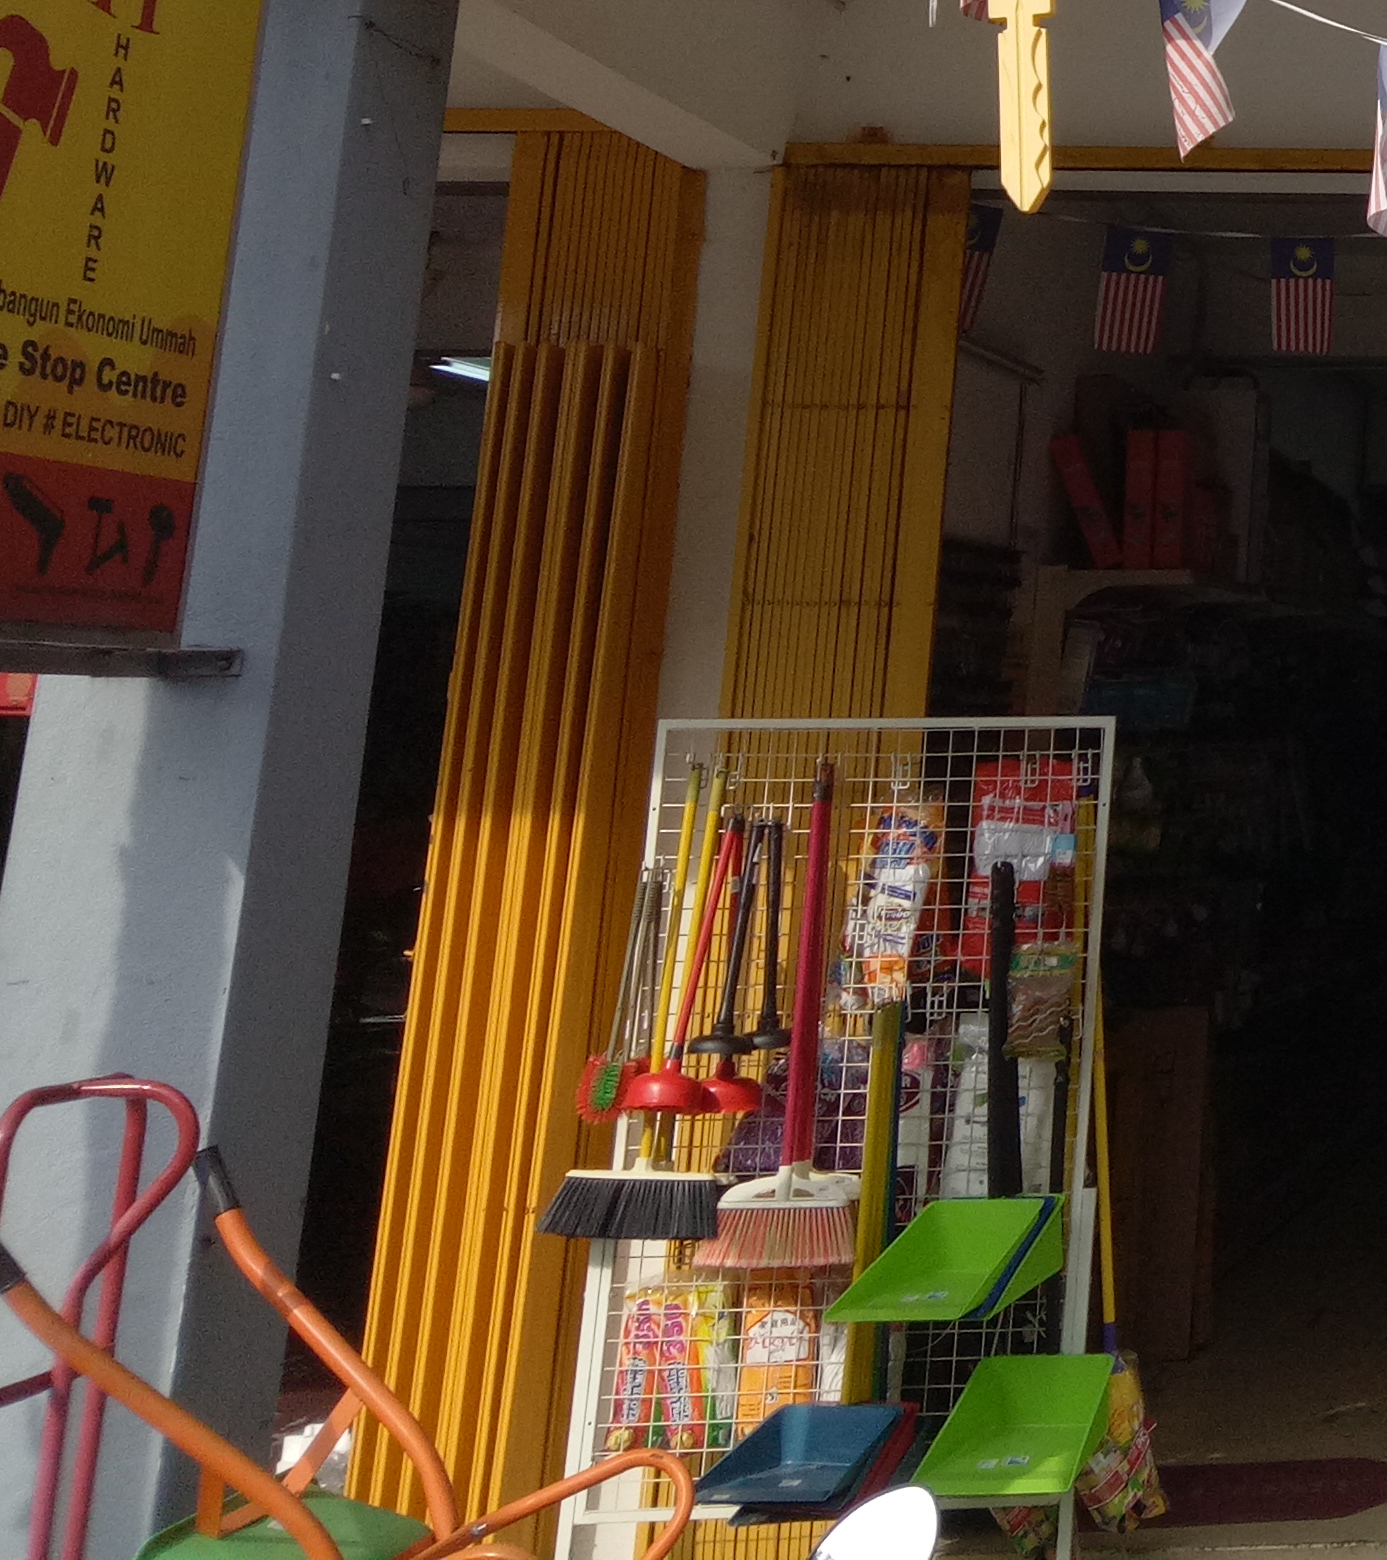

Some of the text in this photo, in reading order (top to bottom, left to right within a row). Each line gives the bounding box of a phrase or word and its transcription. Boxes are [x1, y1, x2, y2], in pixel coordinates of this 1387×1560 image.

[64, 297, 136, 342] Ekonomi
[139, 316, 196, 359] Ummah
[18, 338, 87, 395] Stop
[96, 356, 188, 408] Centre
[3, 399, 40, 432] DIY
[61, 410, 188, 458] ELECTRONIC
